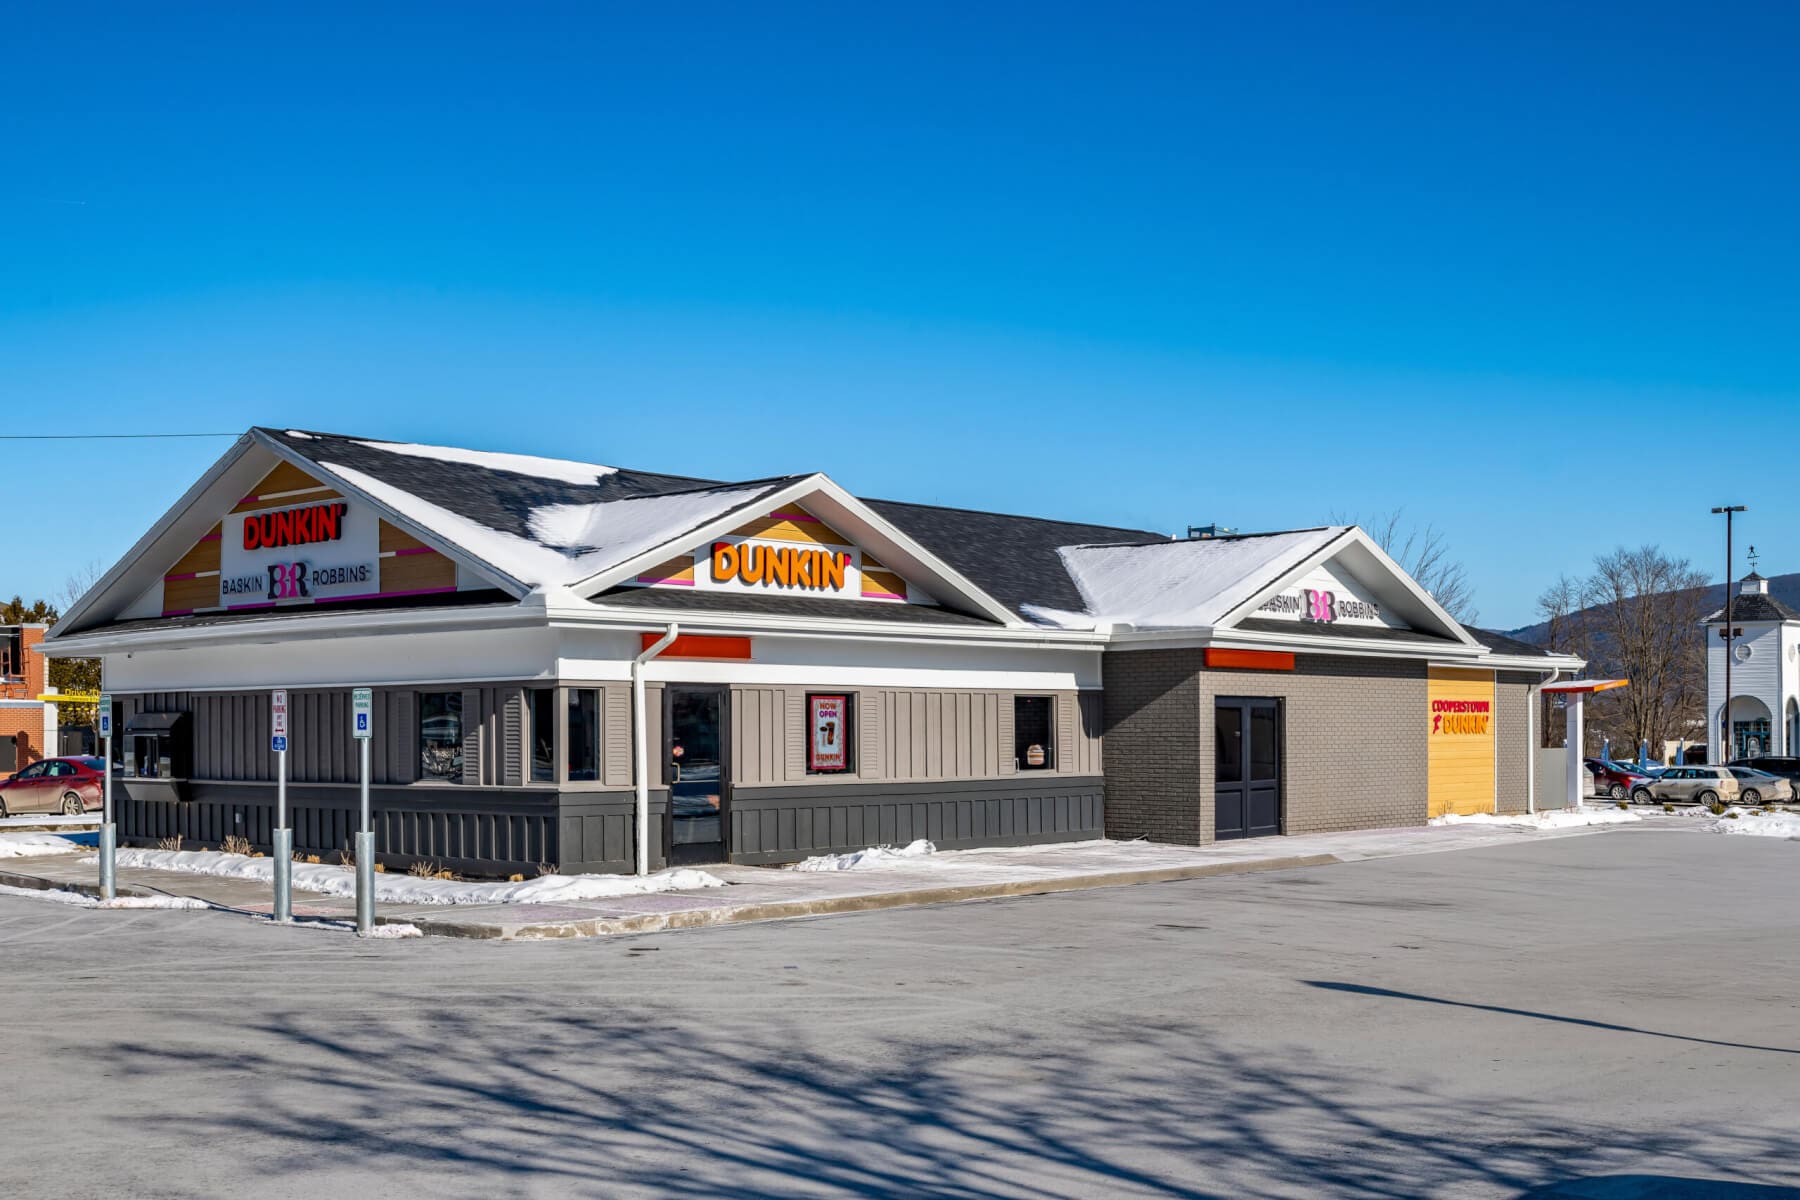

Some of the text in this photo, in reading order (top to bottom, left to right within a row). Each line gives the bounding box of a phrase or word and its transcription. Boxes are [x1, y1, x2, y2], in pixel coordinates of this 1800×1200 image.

[243, 502, 347, 551] DUNKIN'
[222, 575, 263, 595] BASKIN
[312, 564, 367, 586] ROBBINS
[711, 541, 852, 592] DUNKIN'
[1339, 600, 1380, 619] ROBBINS
[819, 710, 837, 718] OPEN
[1443, 714, 1489, 735] DUNKIN'
